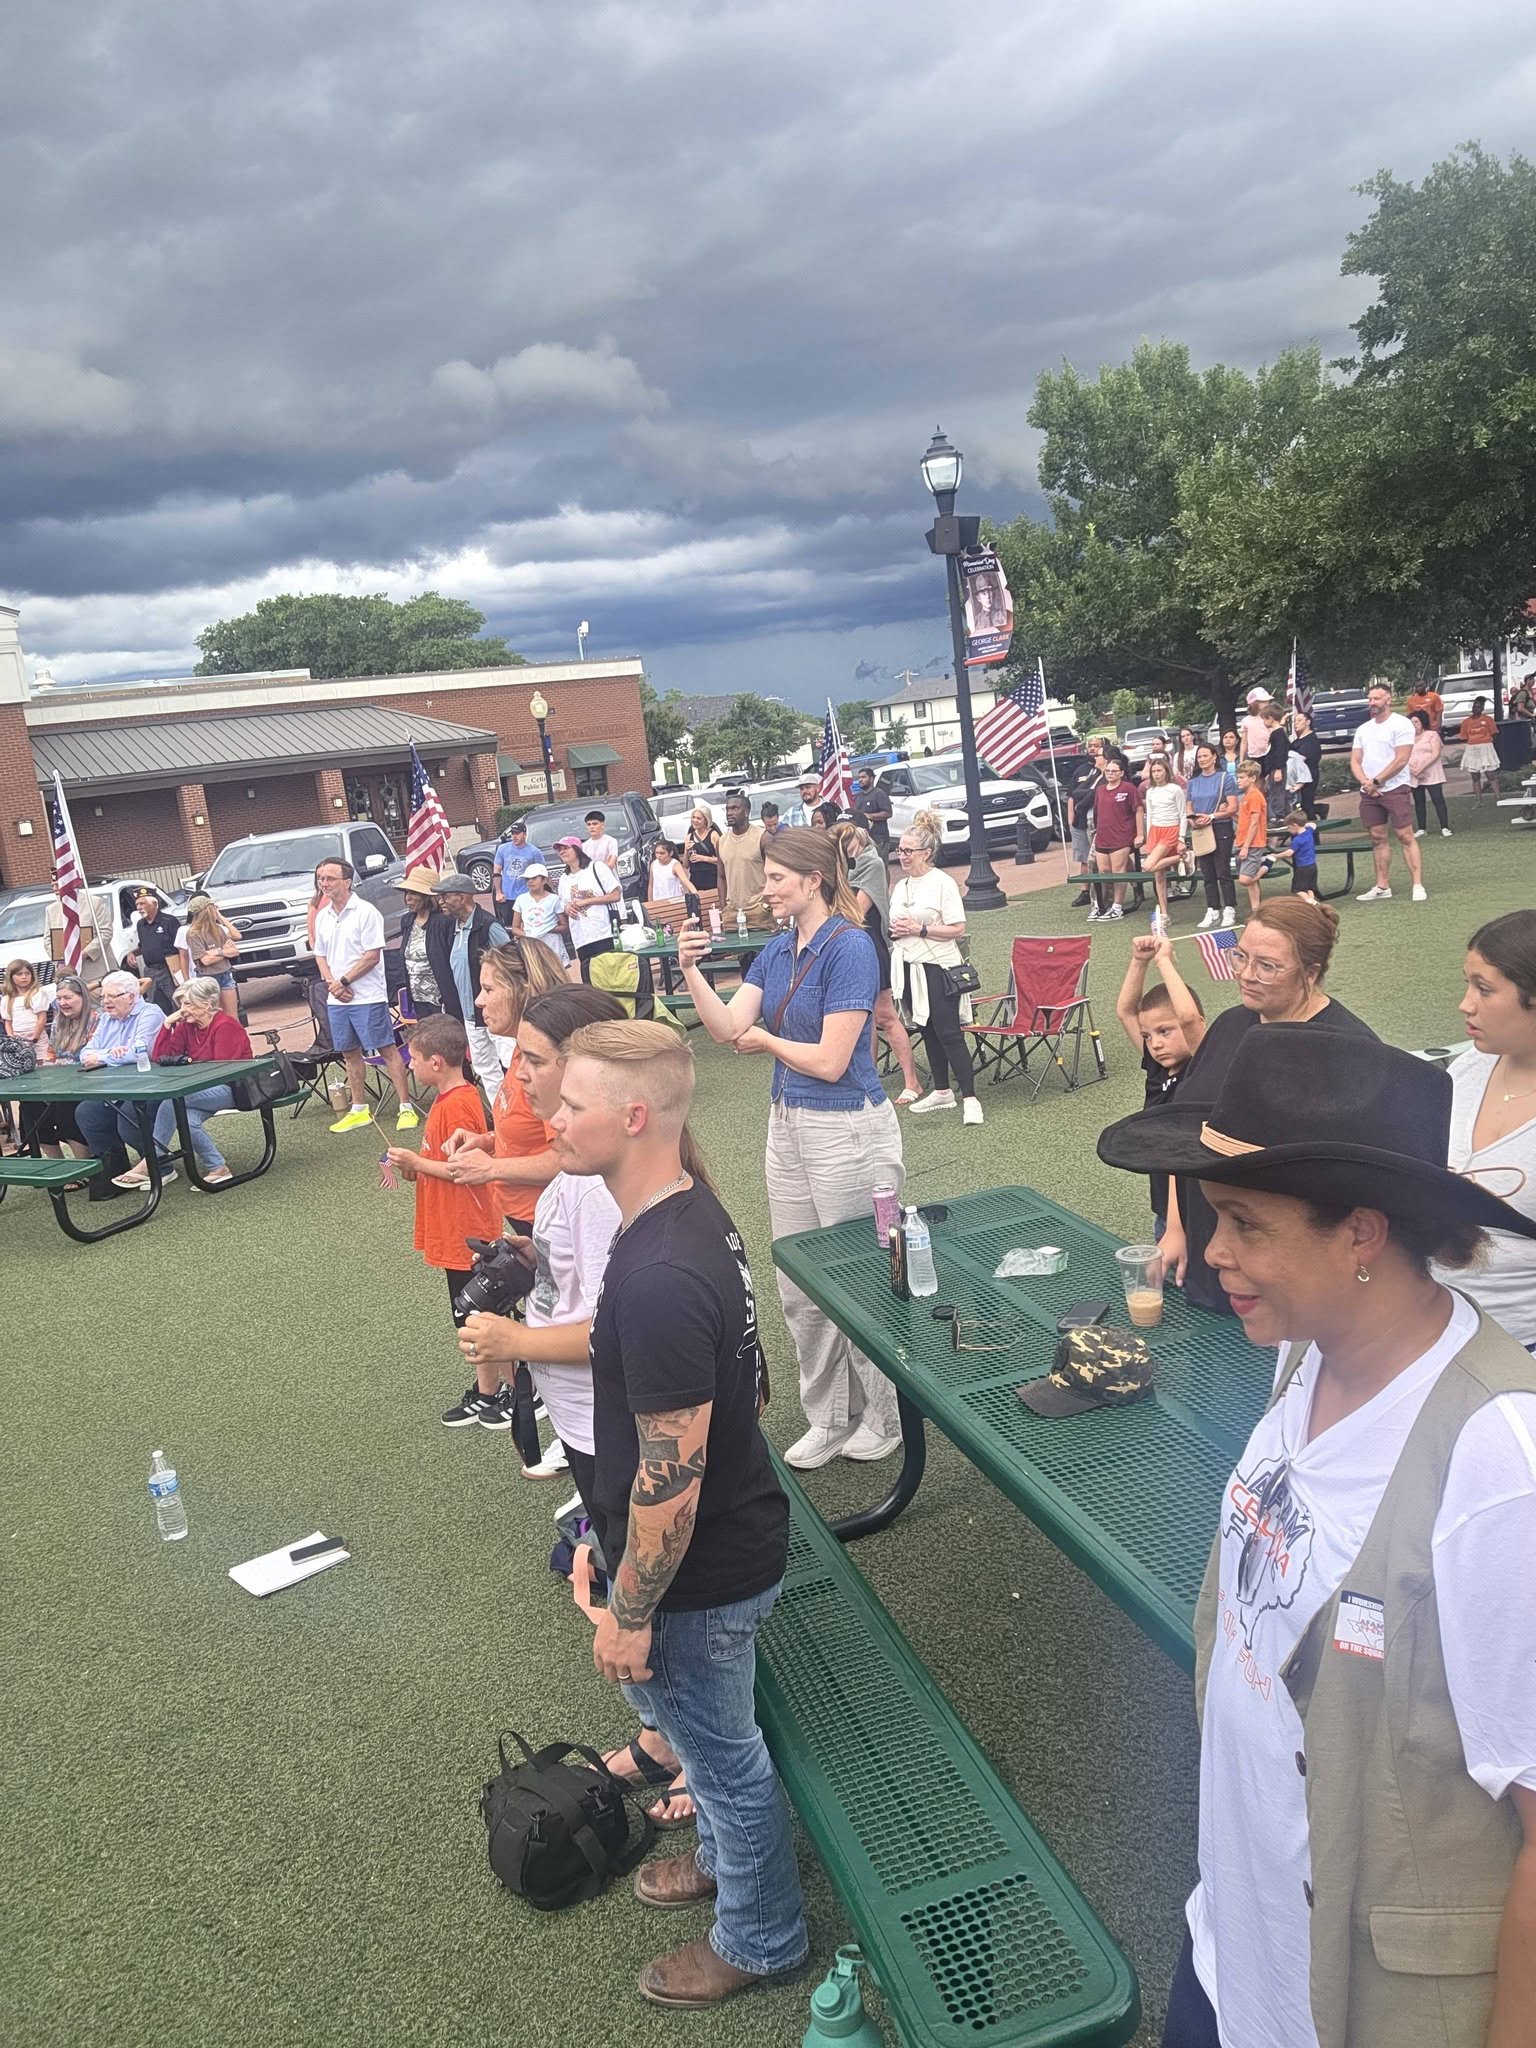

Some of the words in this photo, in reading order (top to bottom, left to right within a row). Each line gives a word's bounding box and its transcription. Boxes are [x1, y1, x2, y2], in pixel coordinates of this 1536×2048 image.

[972, 637, 991, 646] GEORGE
[523, 783, 540, 791] Public
[1350, 1643, 1363, 1654] THE
